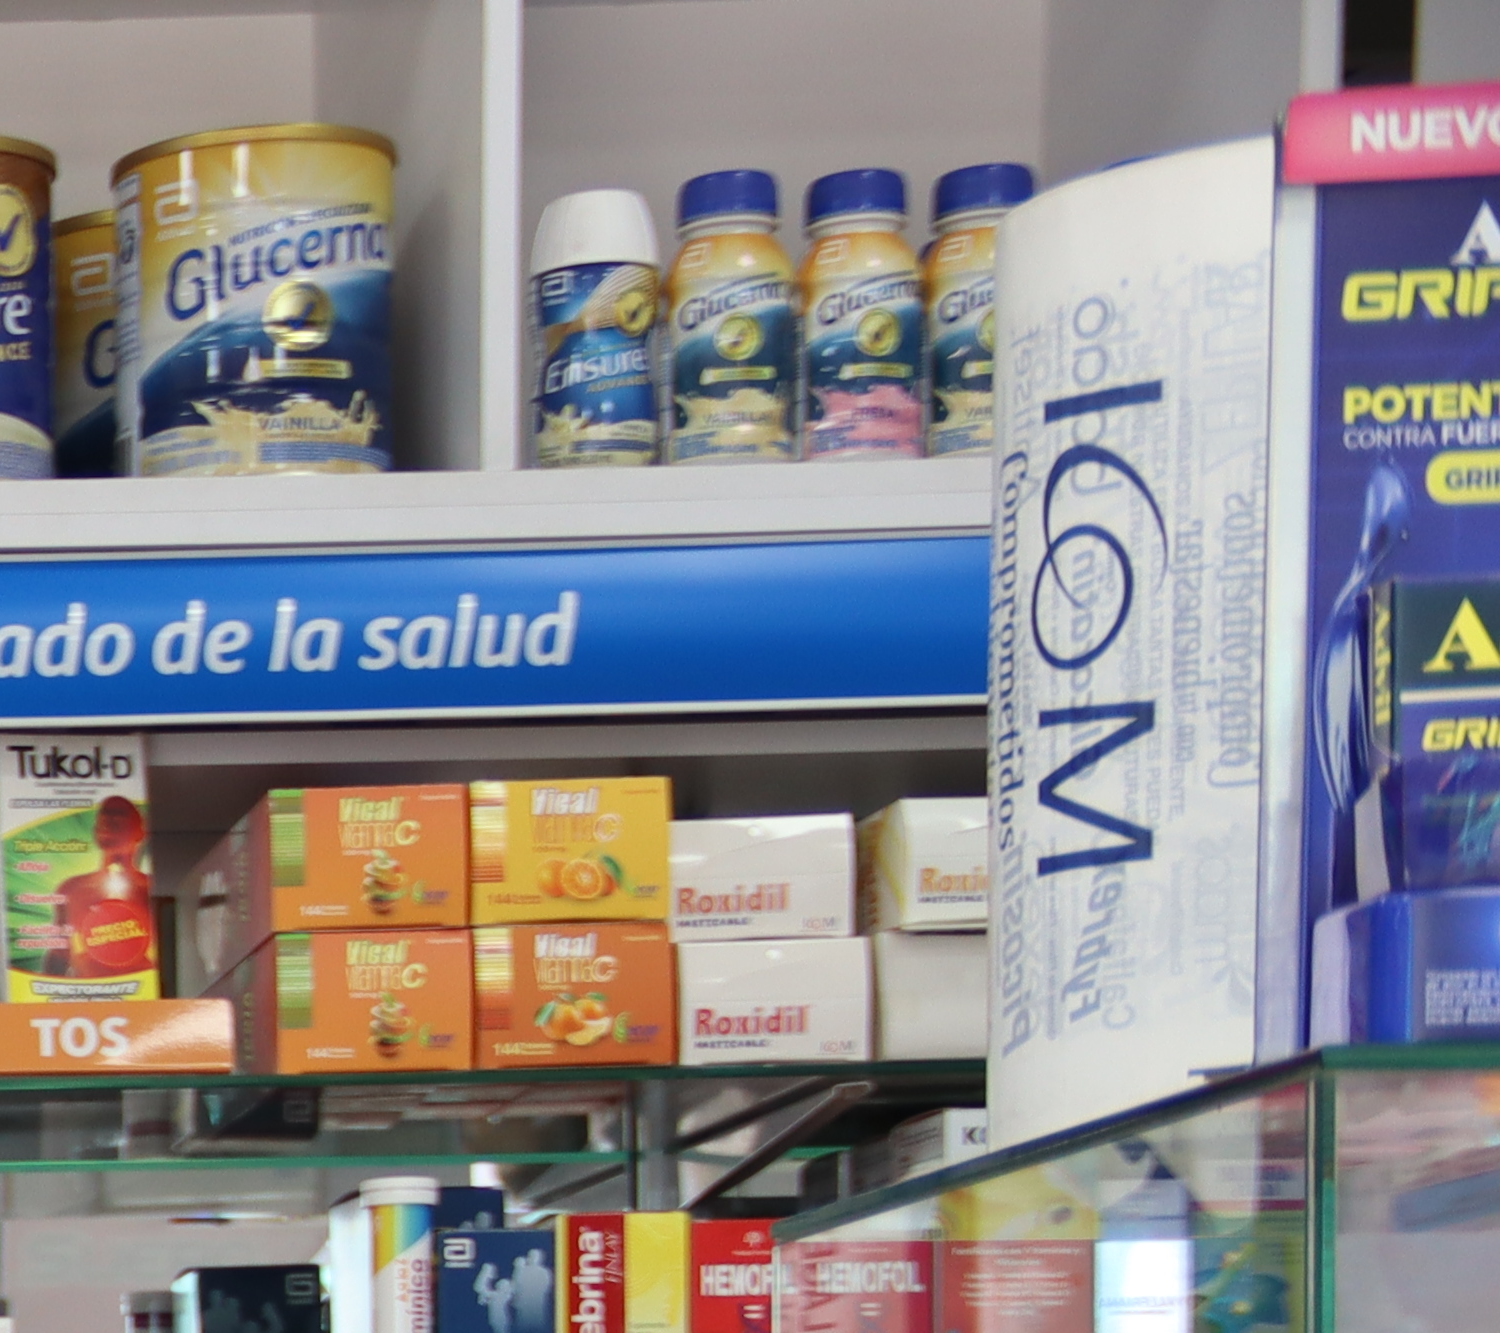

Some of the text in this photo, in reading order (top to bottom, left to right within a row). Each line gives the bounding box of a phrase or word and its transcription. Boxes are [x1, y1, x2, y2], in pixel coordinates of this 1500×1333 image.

[152, 599, 252, 677] de
[267, 596, 338, 674] la
[356, 590, 580, 671] salud
[7, 743, 132, 781] Tukol-D
[676, 885, 790, 916] Roxidil
[29, 1016, 131, 1059] TOS
